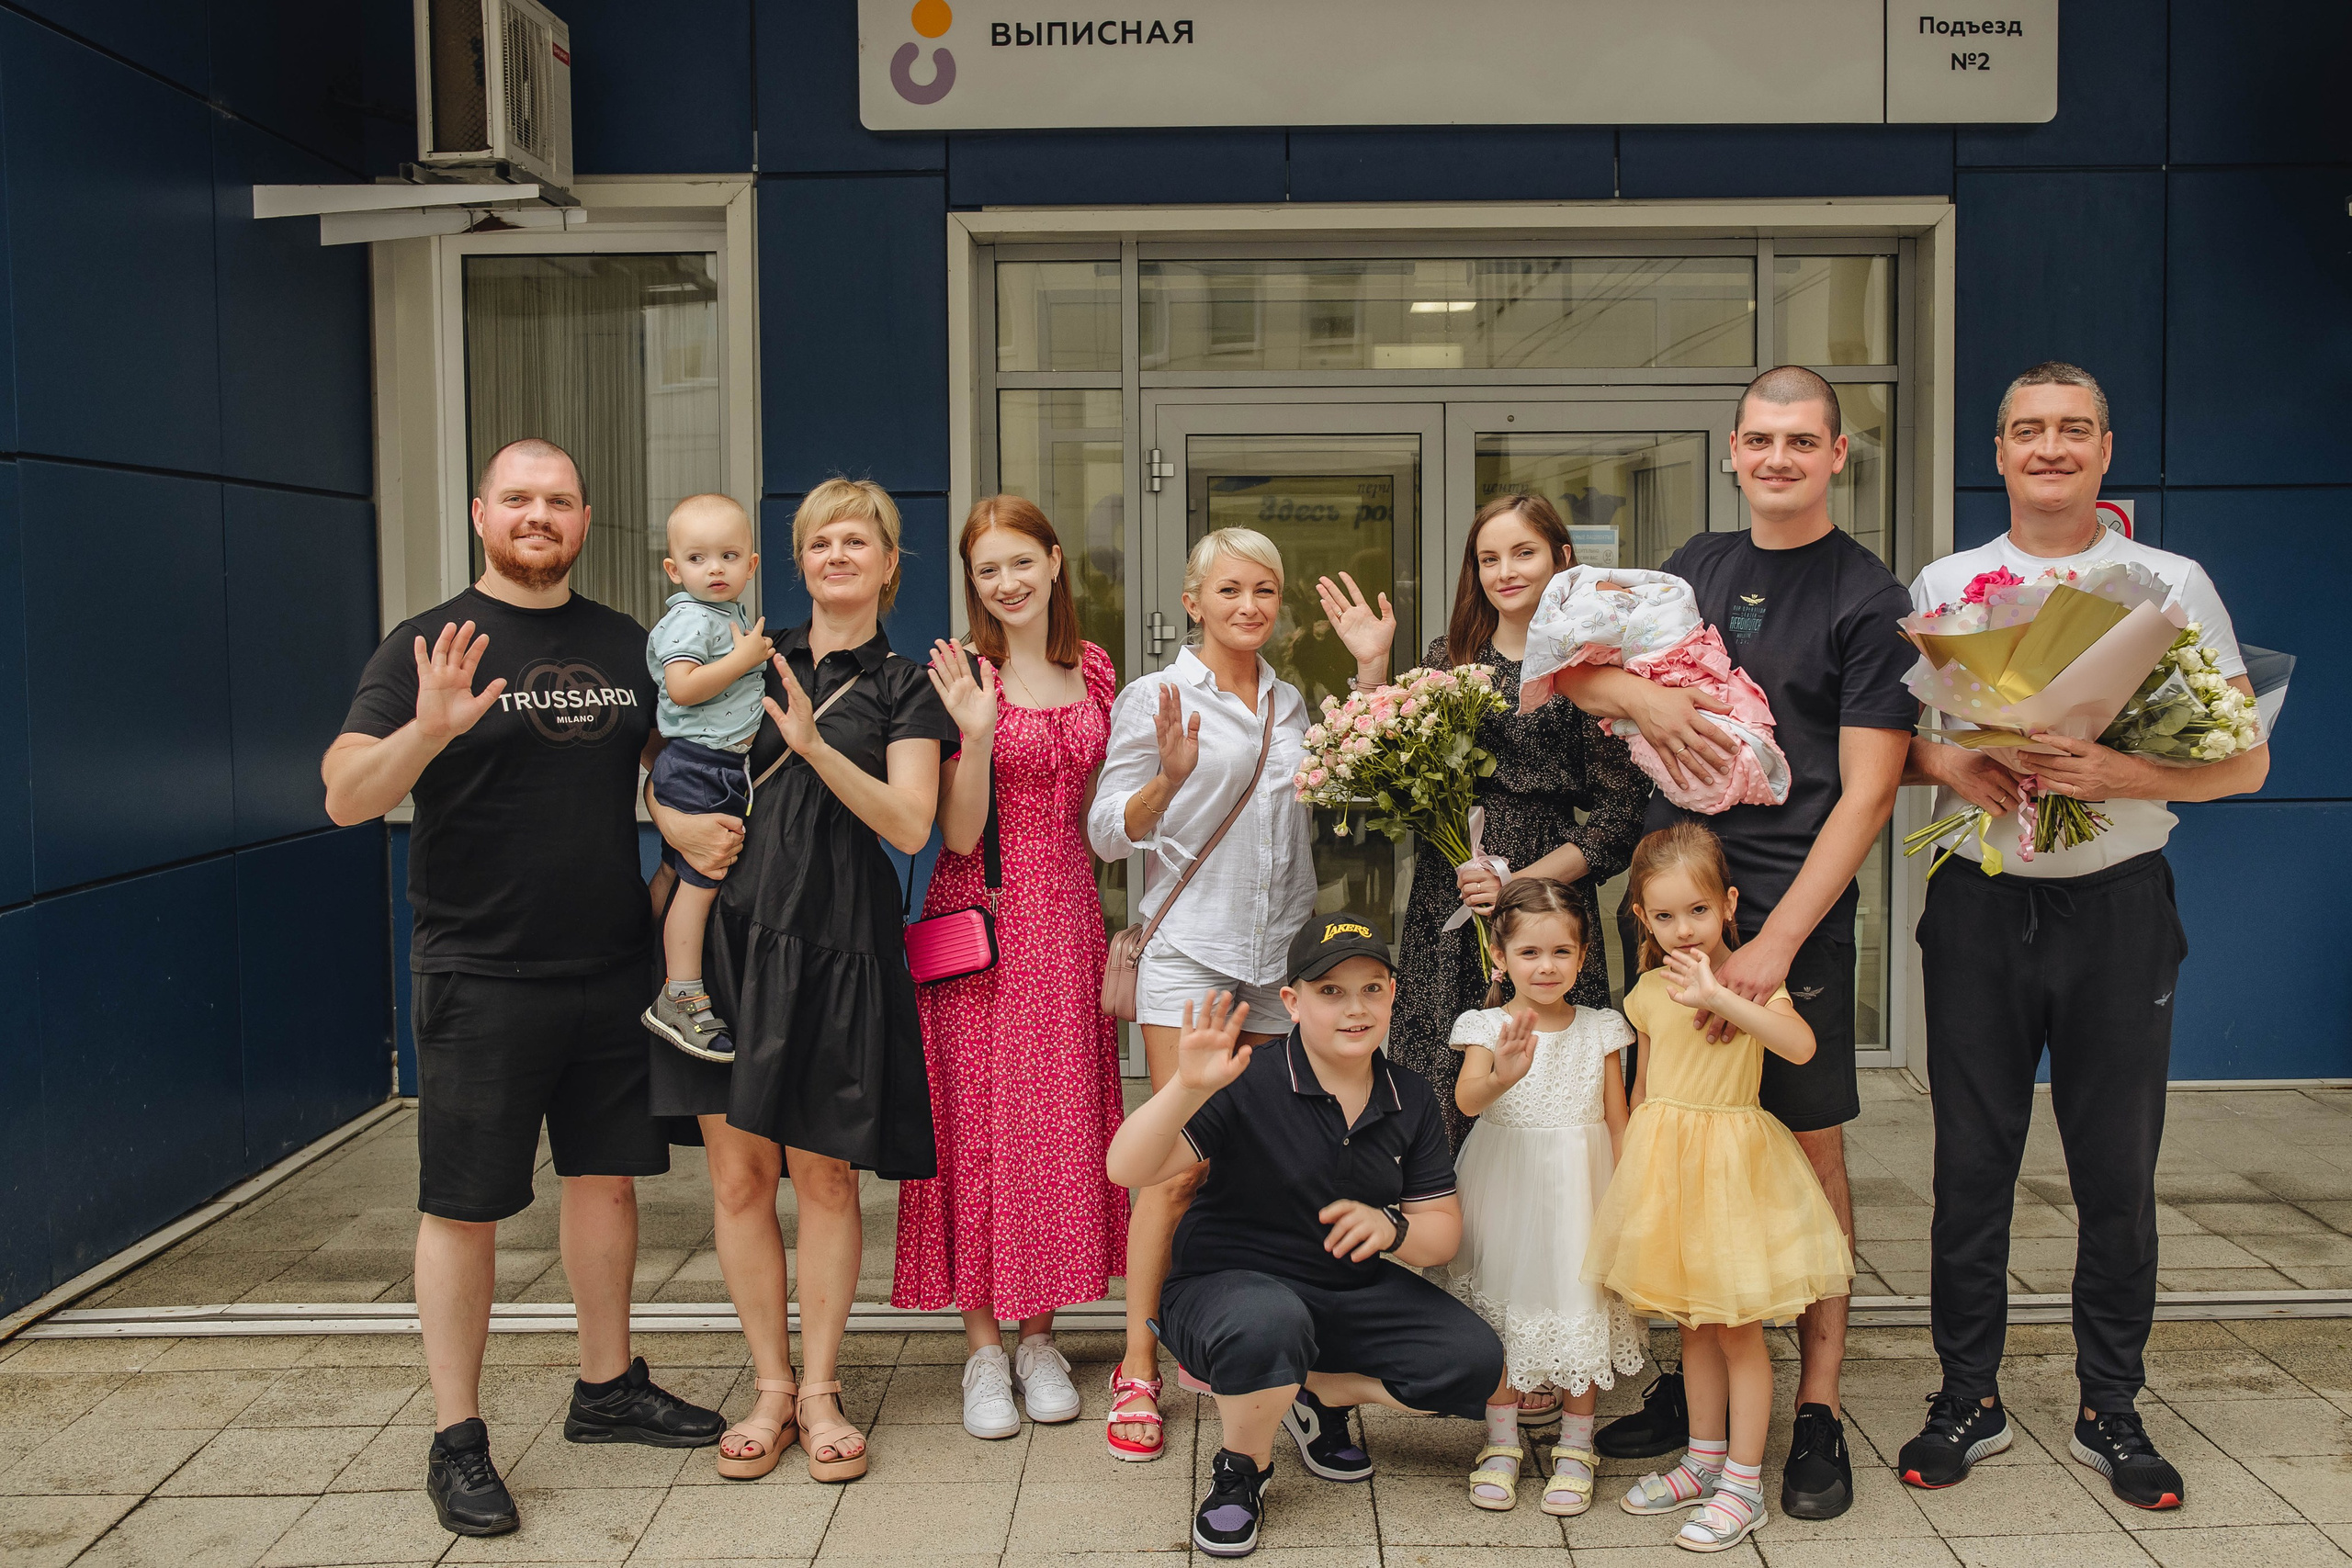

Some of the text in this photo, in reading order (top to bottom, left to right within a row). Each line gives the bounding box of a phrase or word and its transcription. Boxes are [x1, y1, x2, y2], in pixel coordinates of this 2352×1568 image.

[991, 19, 1194, 46] ВЫПИСНАЯ
[1918, 16, 2023, 37] Подъезд
[1951, 52, 1991, 71] №2
[498, 687, 639, 712] TRUSSARDI
[556, 715, 594, 724] MILANO
[1320, 923, 1373, 944] LAKERS
